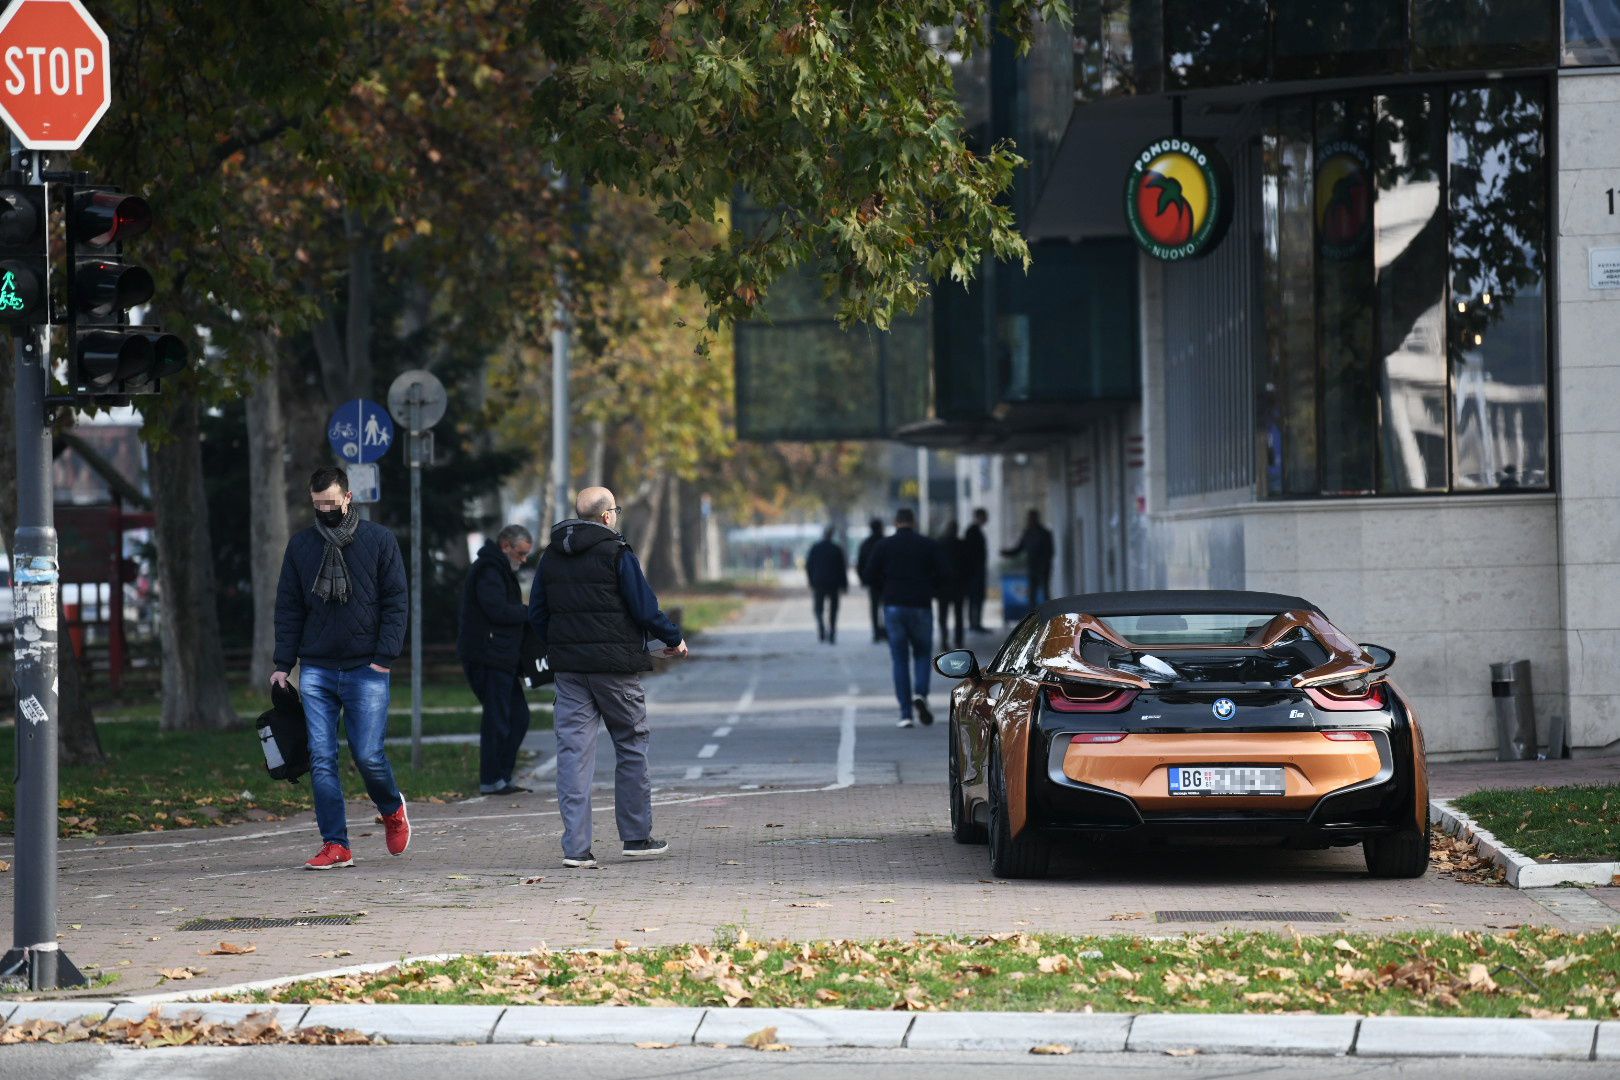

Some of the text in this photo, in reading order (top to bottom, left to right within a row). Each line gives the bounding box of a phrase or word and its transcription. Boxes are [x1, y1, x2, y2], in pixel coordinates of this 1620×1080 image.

[5, 46, 95, 95] STOP
[1135, 139, 1207, 172] POMODORO
[1152, 243, 1195, 259] NUOVO
[1182, 771, 1202, 787] BG
